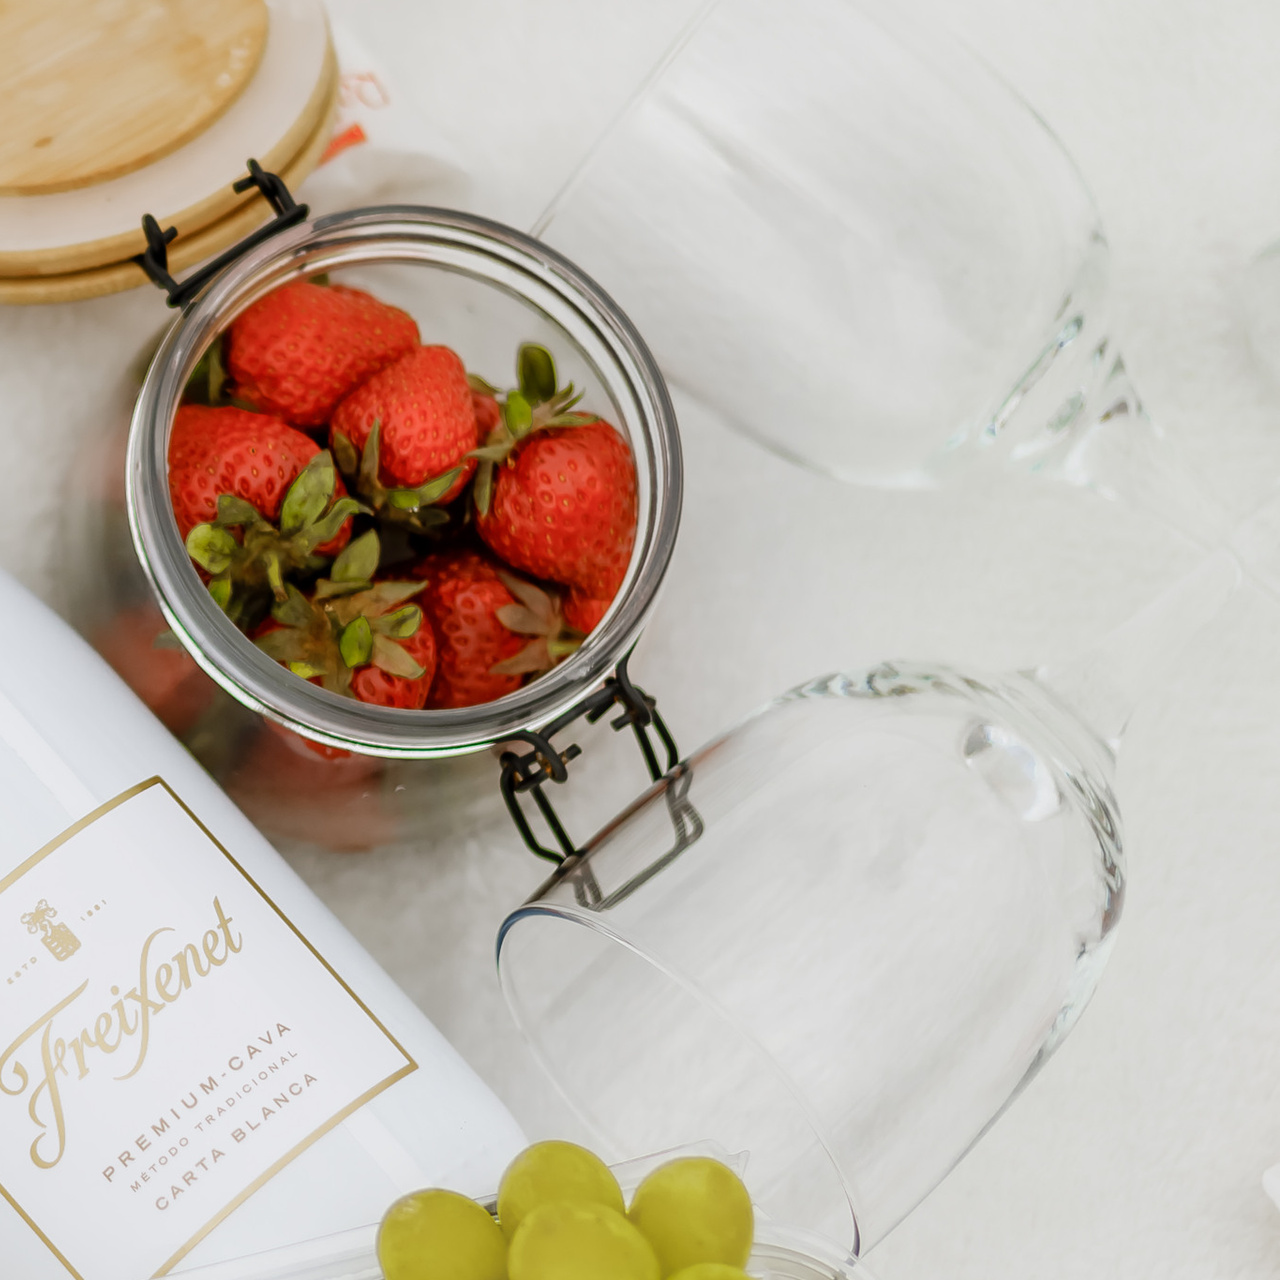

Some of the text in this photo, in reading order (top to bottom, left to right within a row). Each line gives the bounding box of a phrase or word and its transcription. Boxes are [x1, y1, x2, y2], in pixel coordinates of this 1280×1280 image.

[101, 1022, 292, 1183] PREMIUM-CAVA
[129, 1050, 298, 1193] MÉTODO TRADICIONAL
[154, 1072, 318, 1211] CARTA BLANCA
